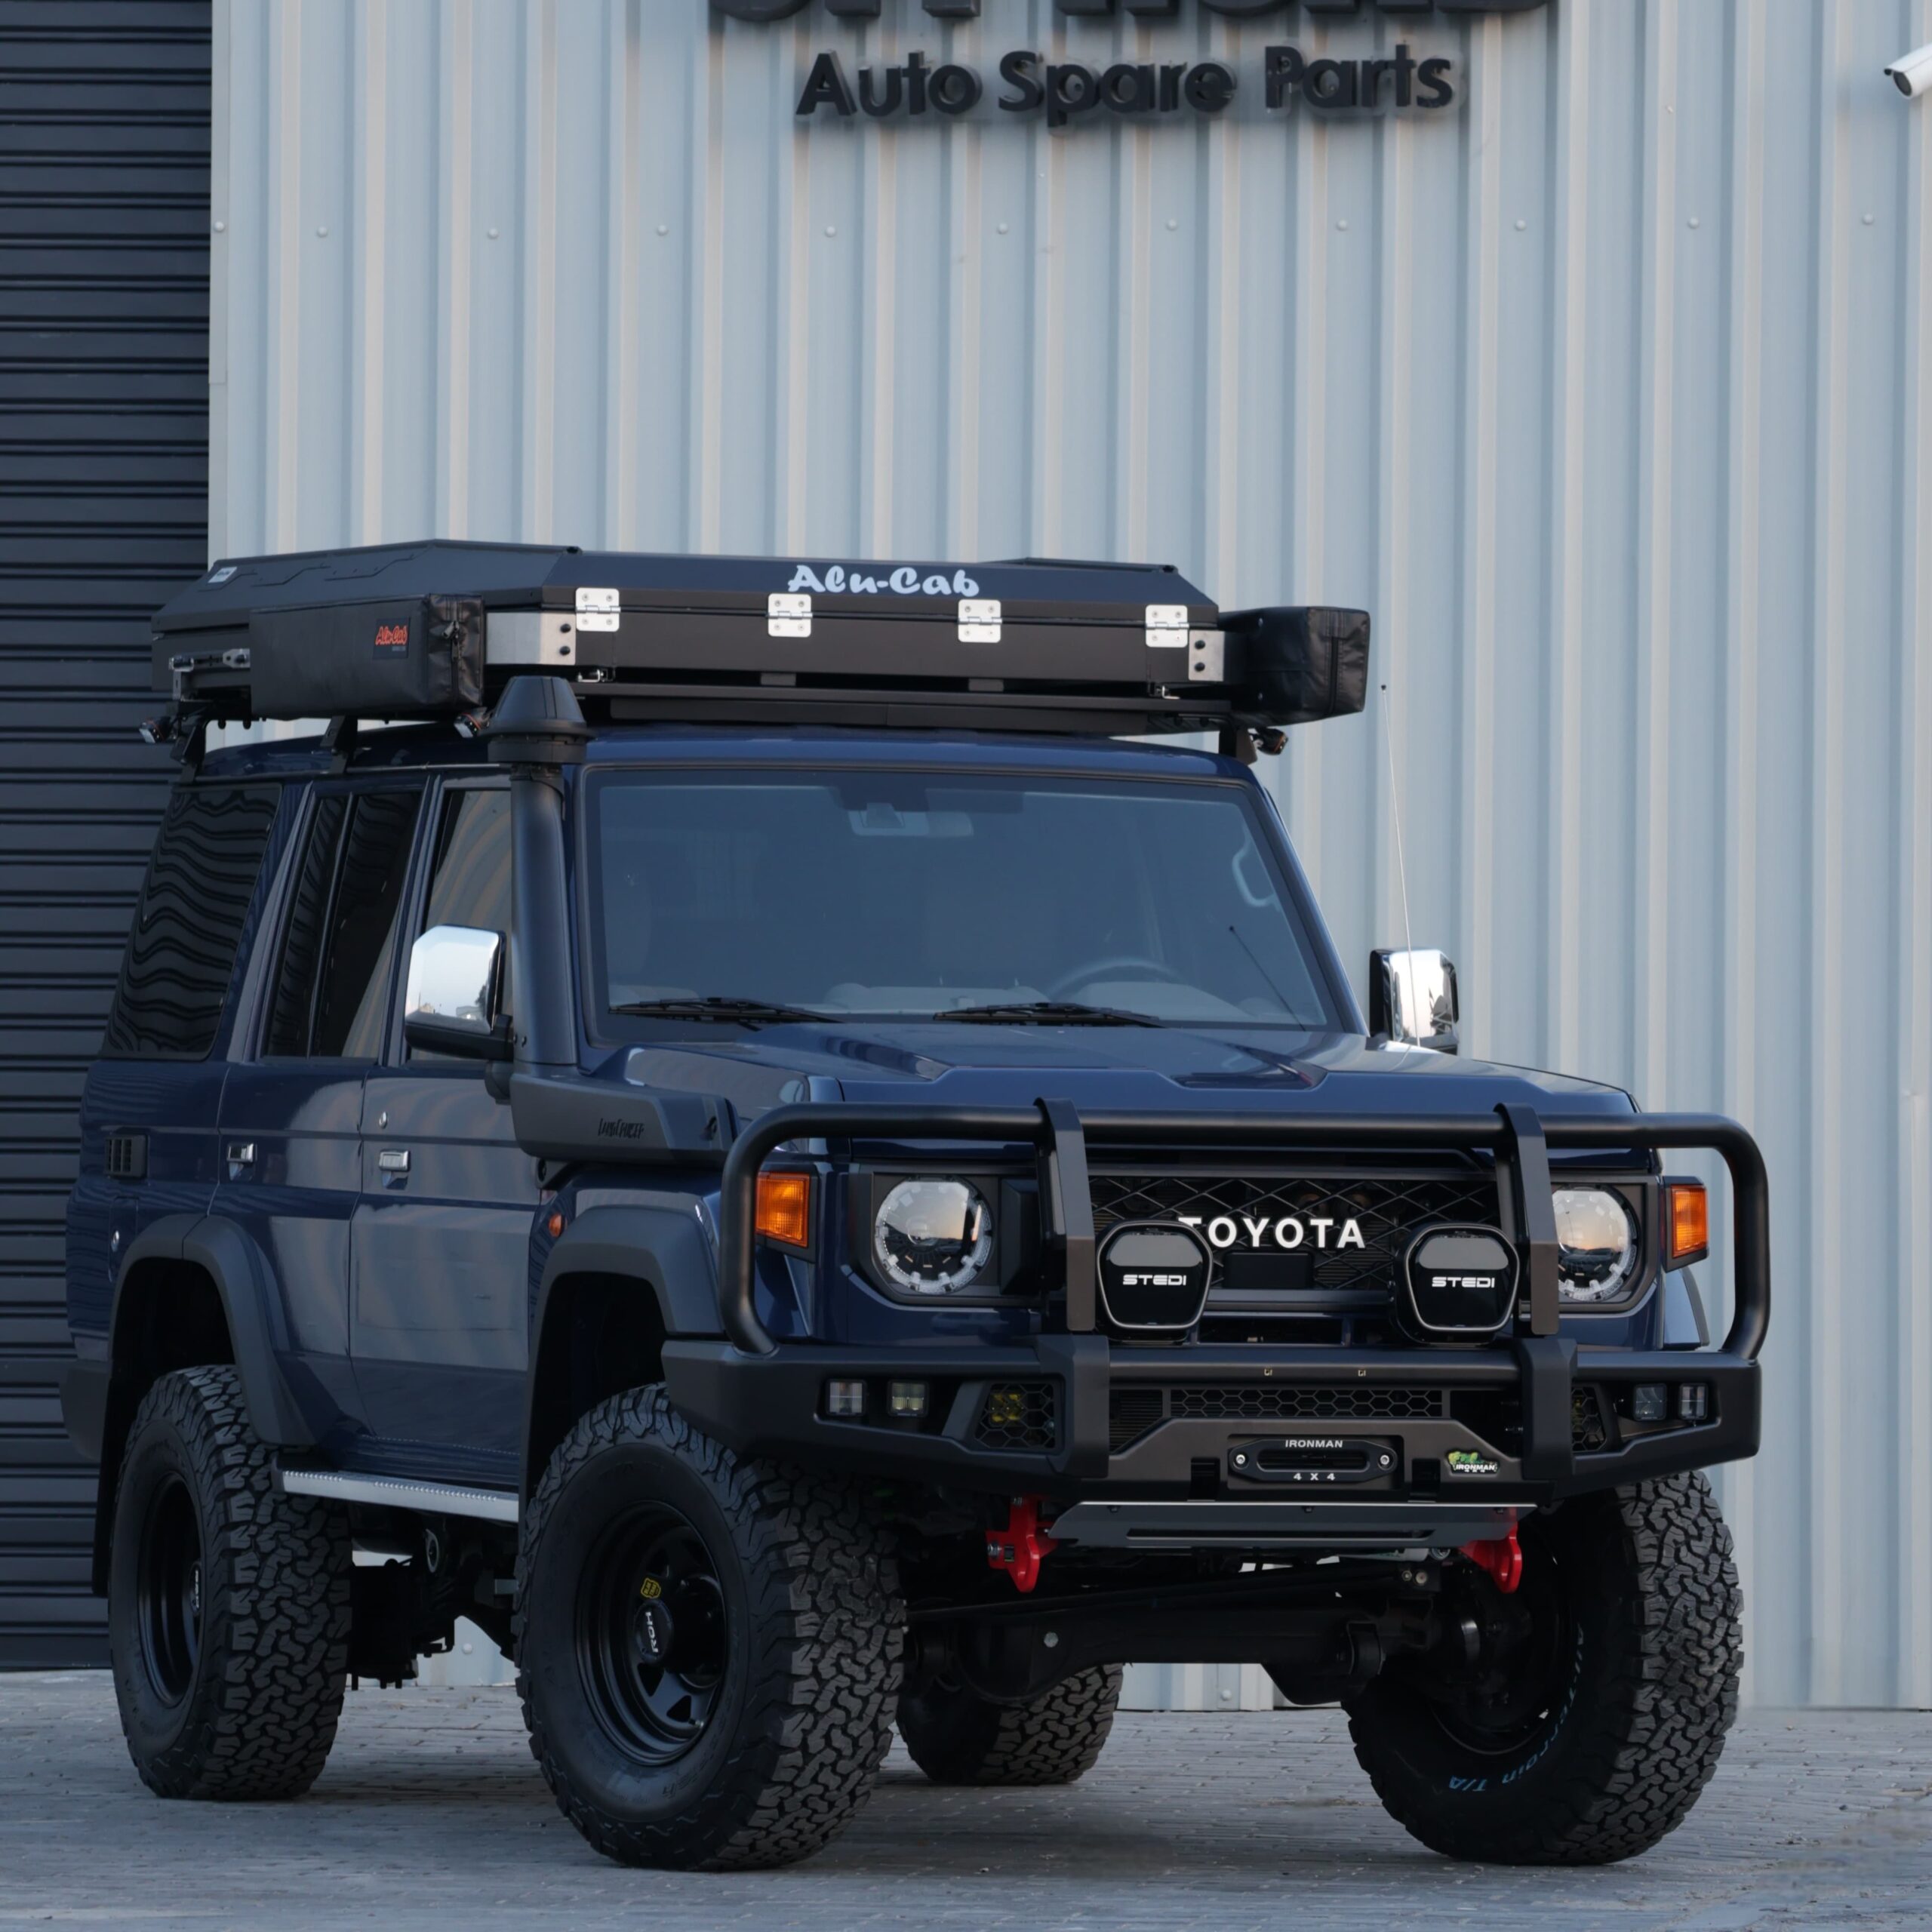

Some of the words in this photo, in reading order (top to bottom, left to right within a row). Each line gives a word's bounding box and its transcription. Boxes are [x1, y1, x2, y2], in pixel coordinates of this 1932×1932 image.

[796, 50, 982, 116] Auto
[998, 50, 1235, 127] Spare
[1265, 45, 1454, 109] Parts
[788, 565, 980, 597] Alu-Cab
[1123, 1274, 1186, 1285] STEDI
[1432, 1276, 1495, 1288] STEDI
[1285, 1439, 1343, 1448] IRONMAN
[645, 1612, 659, 1653] ROH
[1448, 1774, 1487, 1792] T/A
